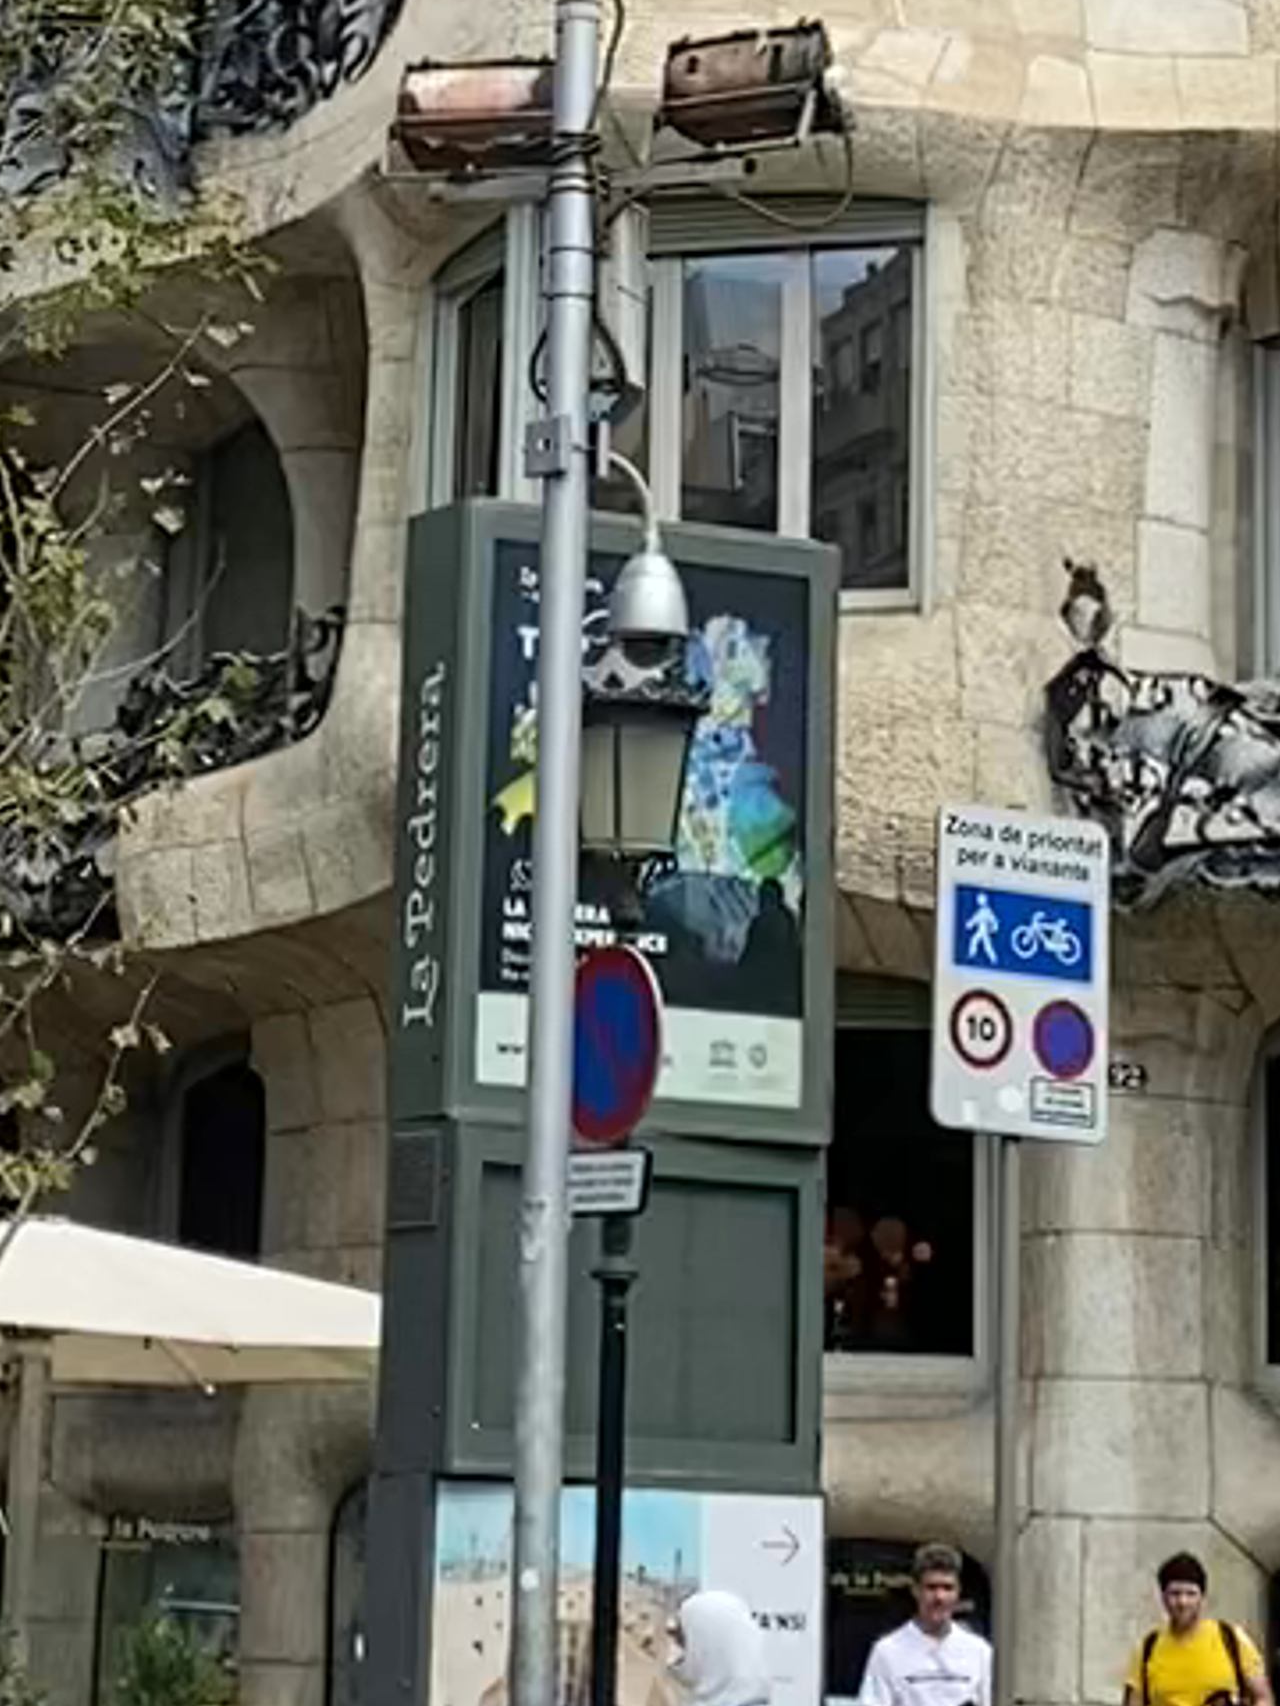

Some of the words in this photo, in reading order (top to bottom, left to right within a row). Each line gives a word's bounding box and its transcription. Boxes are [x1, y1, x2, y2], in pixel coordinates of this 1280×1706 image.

[404, 660, 446, 949] Pedrera
[945, 814, 994, 840] Zona
[998, 825, 1023, 844] de
[1027, 832, 1103, 859] prioritat
[956, 847, 989, 866] per
[994, 854, 1005, 868] a
[403, 953, 440, 1028] La
[967, 1016, 996, 1041] 10
[1110, 1063, 1143, 1090] 92
